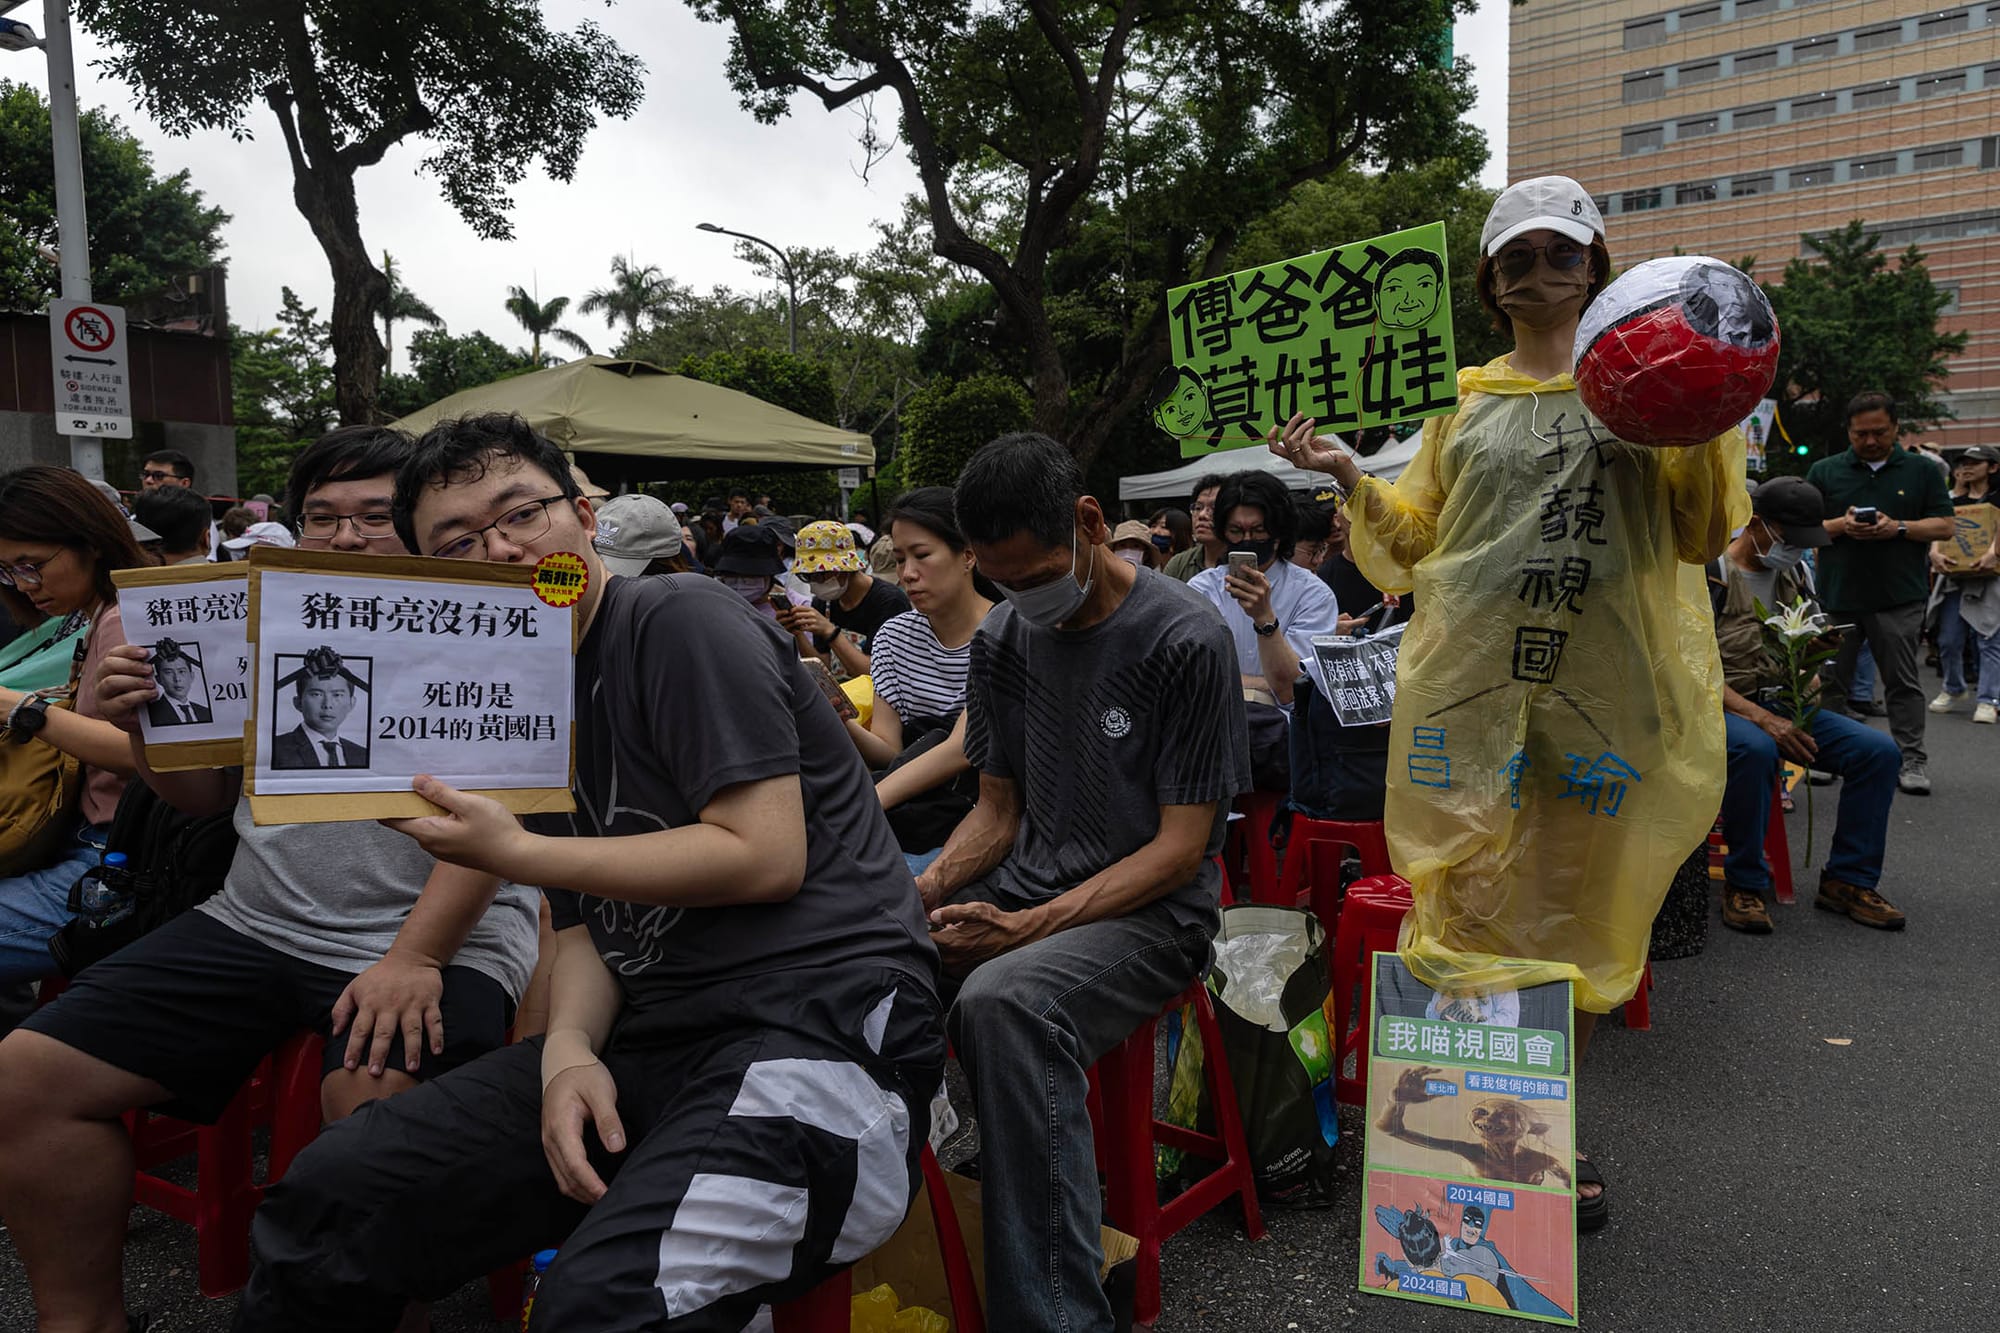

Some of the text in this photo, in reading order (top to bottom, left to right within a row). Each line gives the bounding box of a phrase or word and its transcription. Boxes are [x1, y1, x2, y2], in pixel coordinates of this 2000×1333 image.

[1171, 244, 1391, 358] 傅爸爸
[80, 384, 117, 393] SIDEWALK
[104, 405, 123, 415] ZONE
[95, 421, 118, 431] 110
[301, 592, 538, 639] 豬哥亮沒有死
[1323, 646, 1399, 682] 沒有討論，不是
[423, 681, 514, 710] 死的是
[378, 713, 556, 742] 2014的黃國昌
[1387, 1021, 1555, 1067] 我喵視國會
[1467, 1074, 1565, 1097] 看我俊俏的臉龐
[1265, 1160, 1283, 1172] Think
[1450, 1187, 1510, 1208] 2014國昌
[1402, 1275, 1463, 1297] 2024國昌
